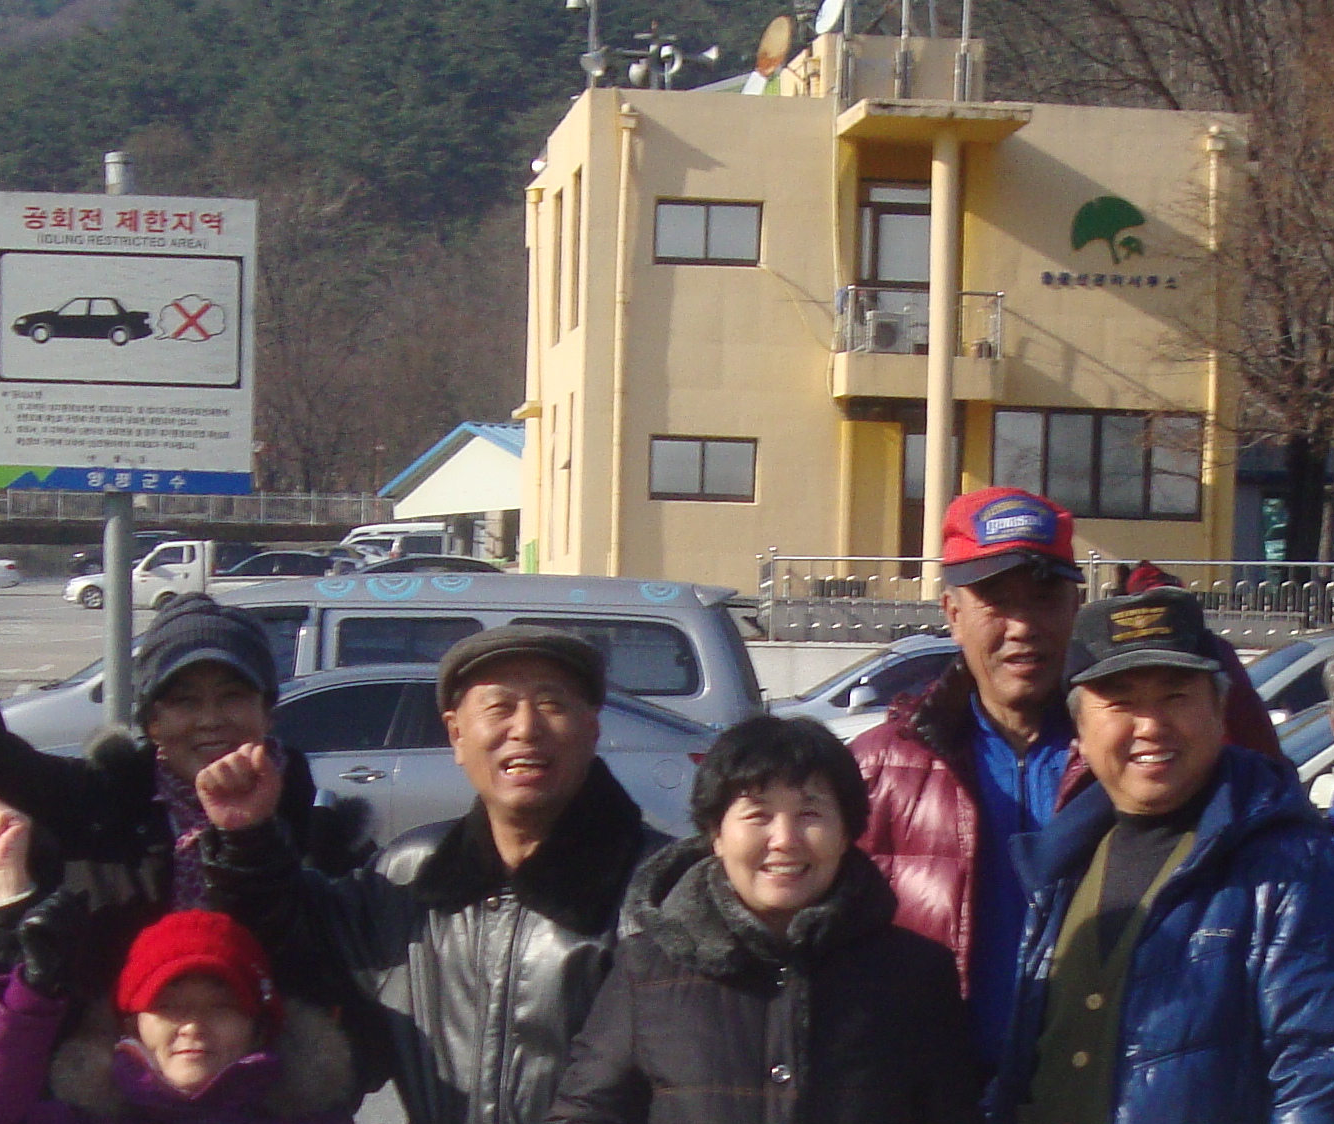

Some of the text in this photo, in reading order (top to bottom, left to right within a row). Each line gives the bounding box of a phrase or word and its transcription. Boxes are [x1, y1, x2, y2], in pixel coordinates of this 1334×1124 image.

[22, 206, 225, 236] 공회전 제한지역
[87, 234, 167, 248] RESTRICTED
[86, 471, 186, 491] 양평군수
